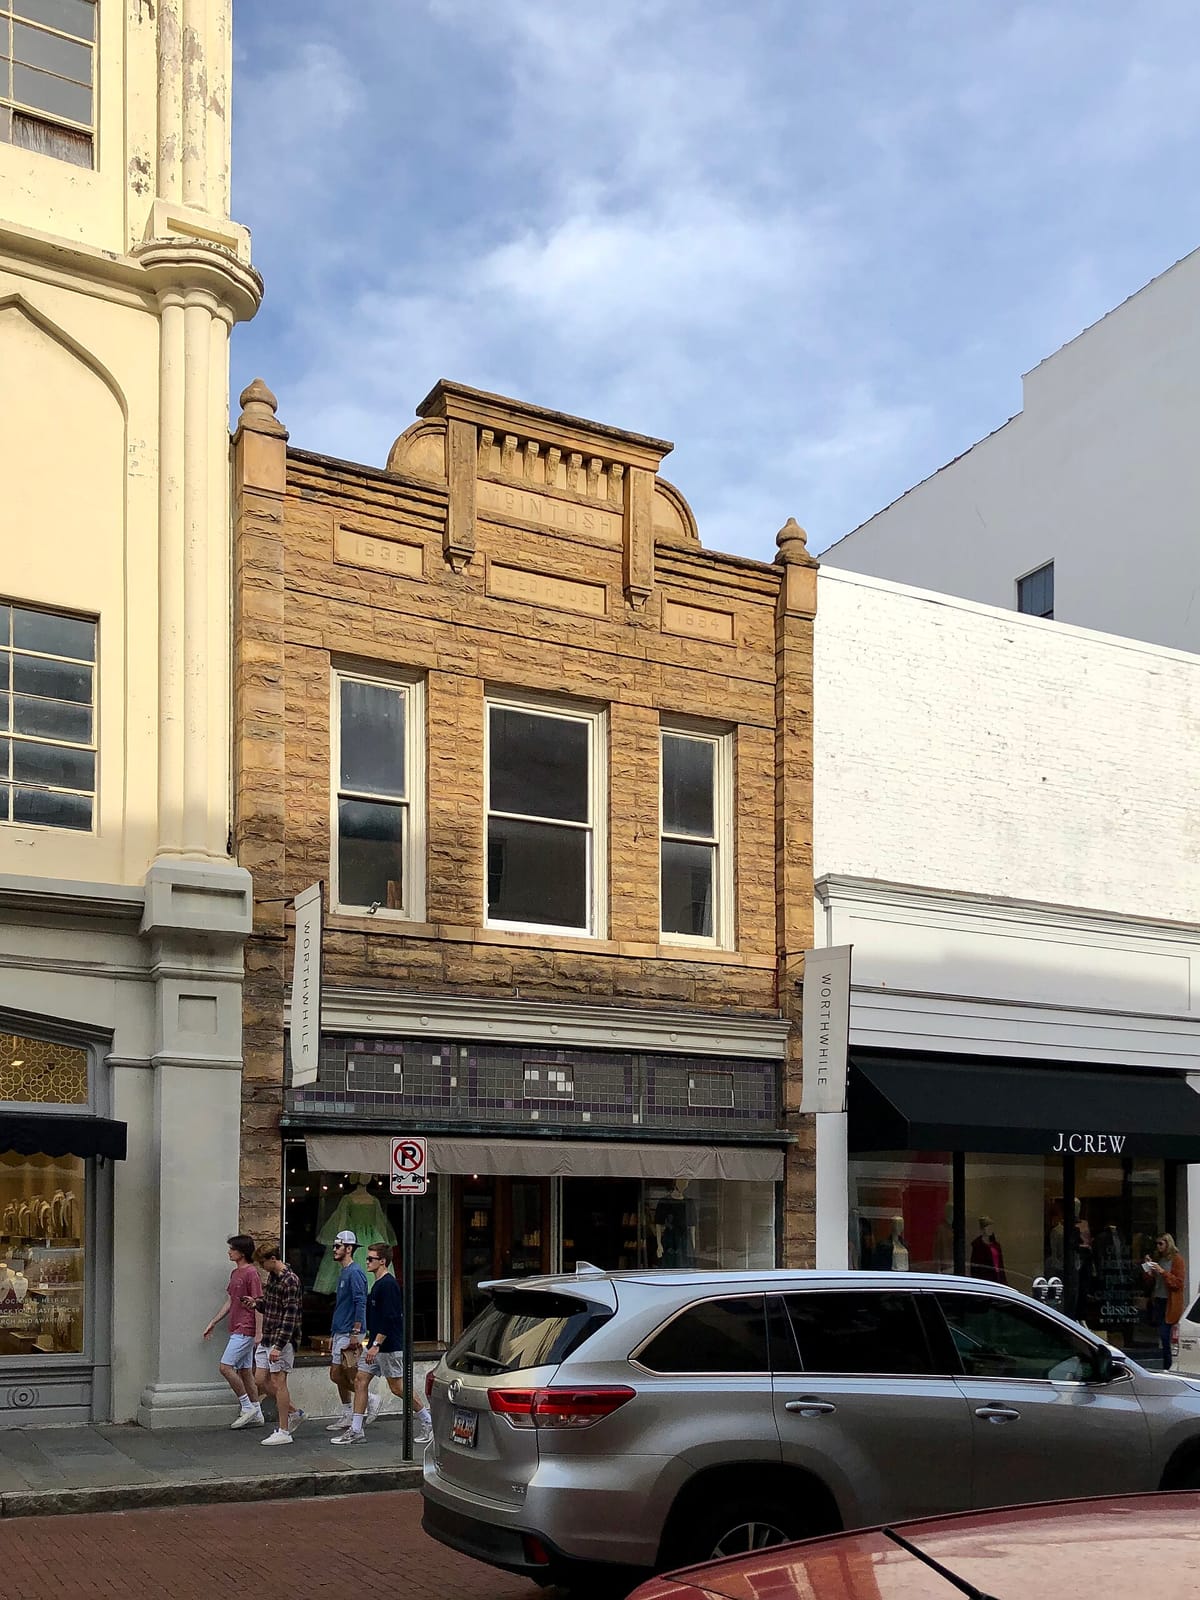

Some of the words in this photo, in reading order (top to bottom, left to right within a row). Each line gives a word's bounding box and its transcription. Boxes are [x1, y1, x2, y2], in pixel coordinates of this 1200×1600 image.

[546, 584, 599, 607] HOUSE
[301, 920, 311, 1054] WORTHWHILE
[817, 973, 832, 1086] WORTHWHILE
[1053, 1132, 1126, 1154] J.CREW
[1101, 1301, 1138, 1315] classics
